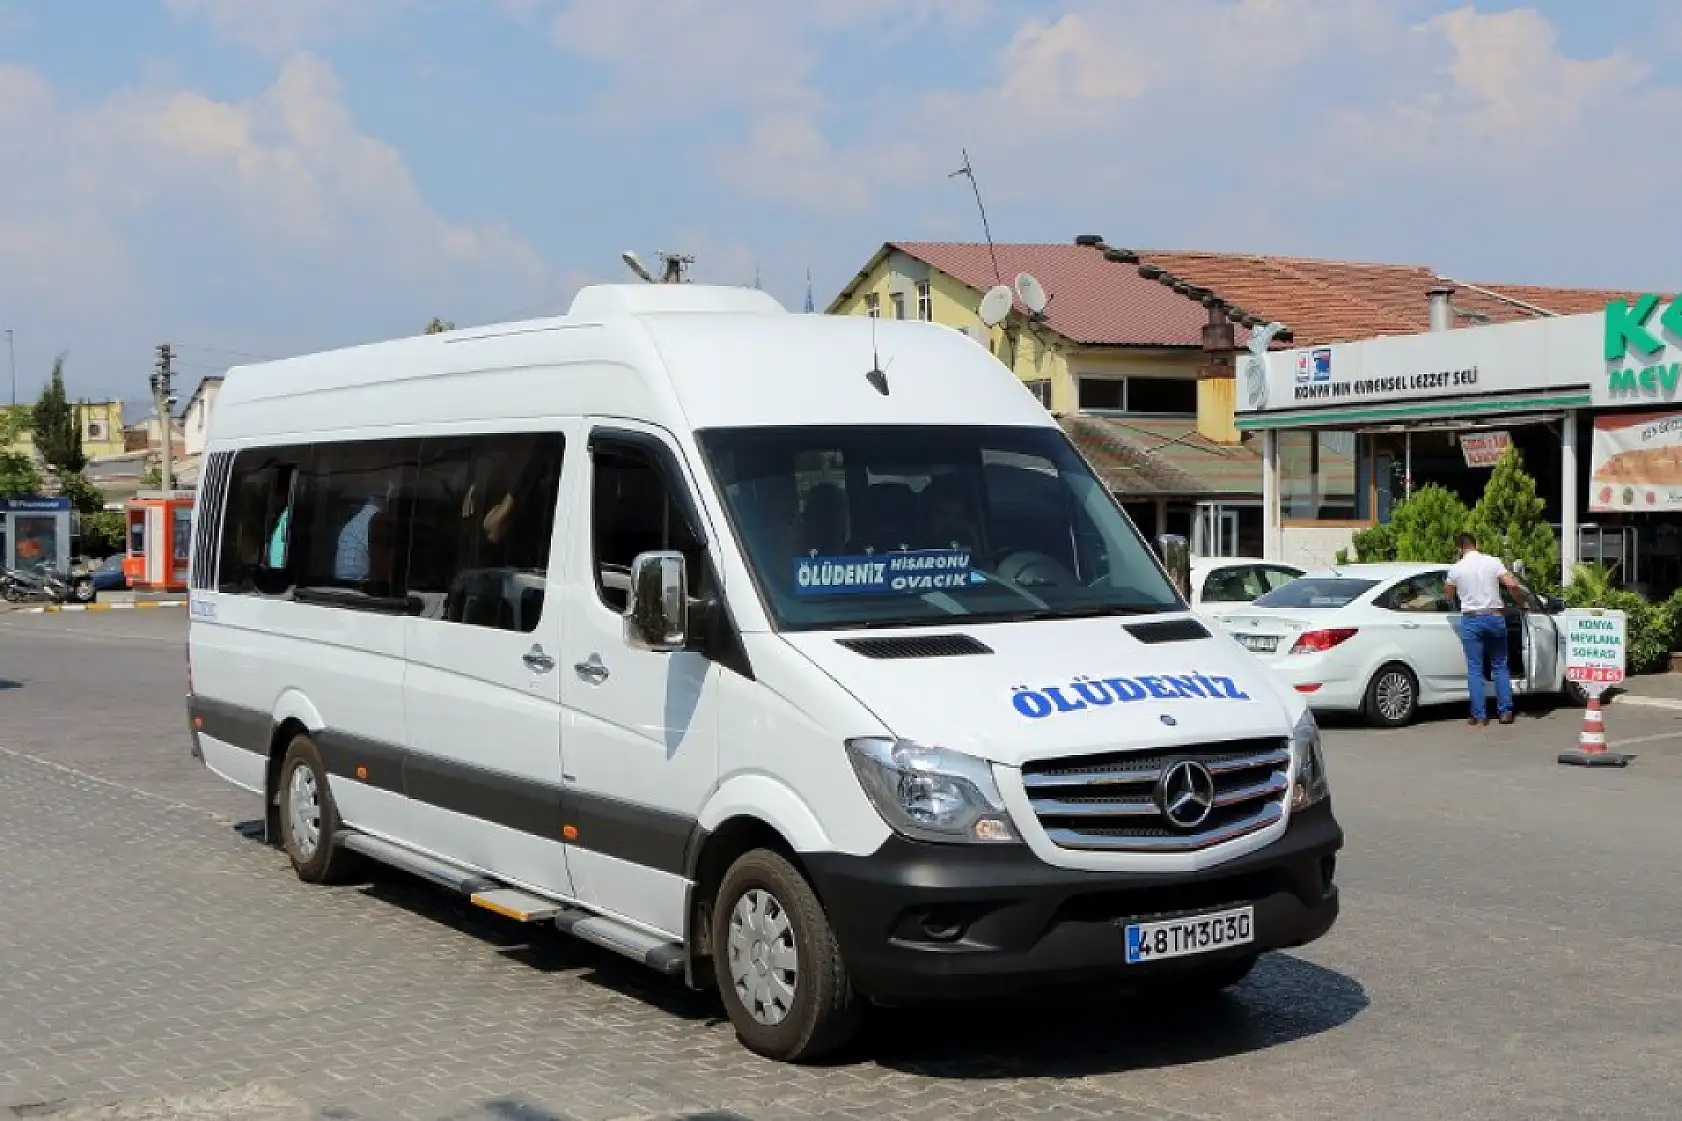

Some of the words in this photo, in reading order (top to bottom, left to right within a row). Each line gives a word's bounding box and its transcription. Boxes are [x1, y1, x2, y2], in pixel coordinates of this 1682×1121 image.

[1354, 376, 1407, 395] EVRENSEL
[1410, 371, 1450, 390] LEZZET
[891, 573, 967, 589] OVACIK
[1011, 670, 1251, 719] ÖLÜDENİZ
